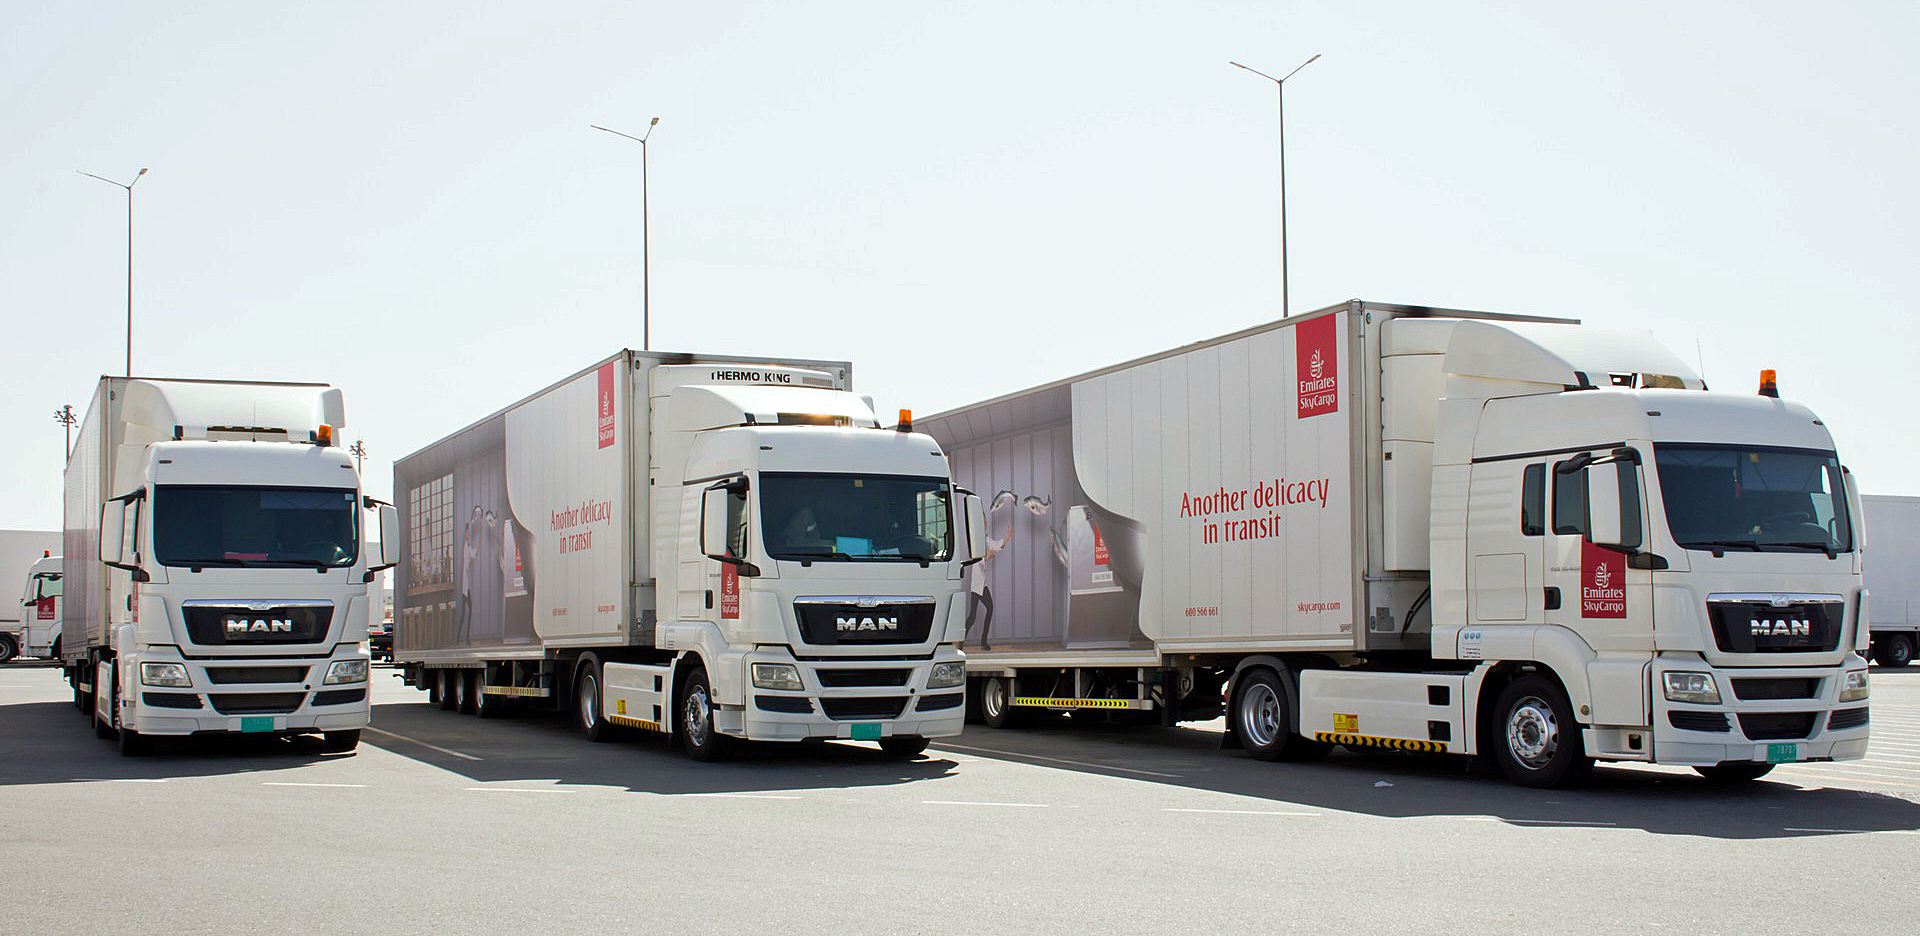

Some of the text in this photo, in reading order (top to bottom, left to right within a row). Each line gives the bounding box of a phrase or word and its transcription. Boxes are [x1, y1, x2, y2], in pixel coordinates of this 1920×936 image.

[764, 372, 791, 383] KING
[1300, 377, 1335, 394] Emirates
[1300, 393, 1336, 410] SkyCargo
[1180, 477, 1329, 518] Another delicacy
[550, 499, 612, 532] Another delicacy
[1203, 510, 1281, 544] in transit
[560, 526, 593, 554] in transit
[721, 593, 739, 602] Emirates
[1583, 587, 1624, 599] Emirates
[721, 604, 739, 614] SkyCargo
[1184, 606, 1218, 617] 600 566 661
[1297, 601, 1341, 614] skycargo.com
[1583, 601, 1624, 612] SkyCargo
[227, 619, 292, 632] MAN
[836, 617, 898, 631] MAN
[1750, 619, 1810, 636] MAN
